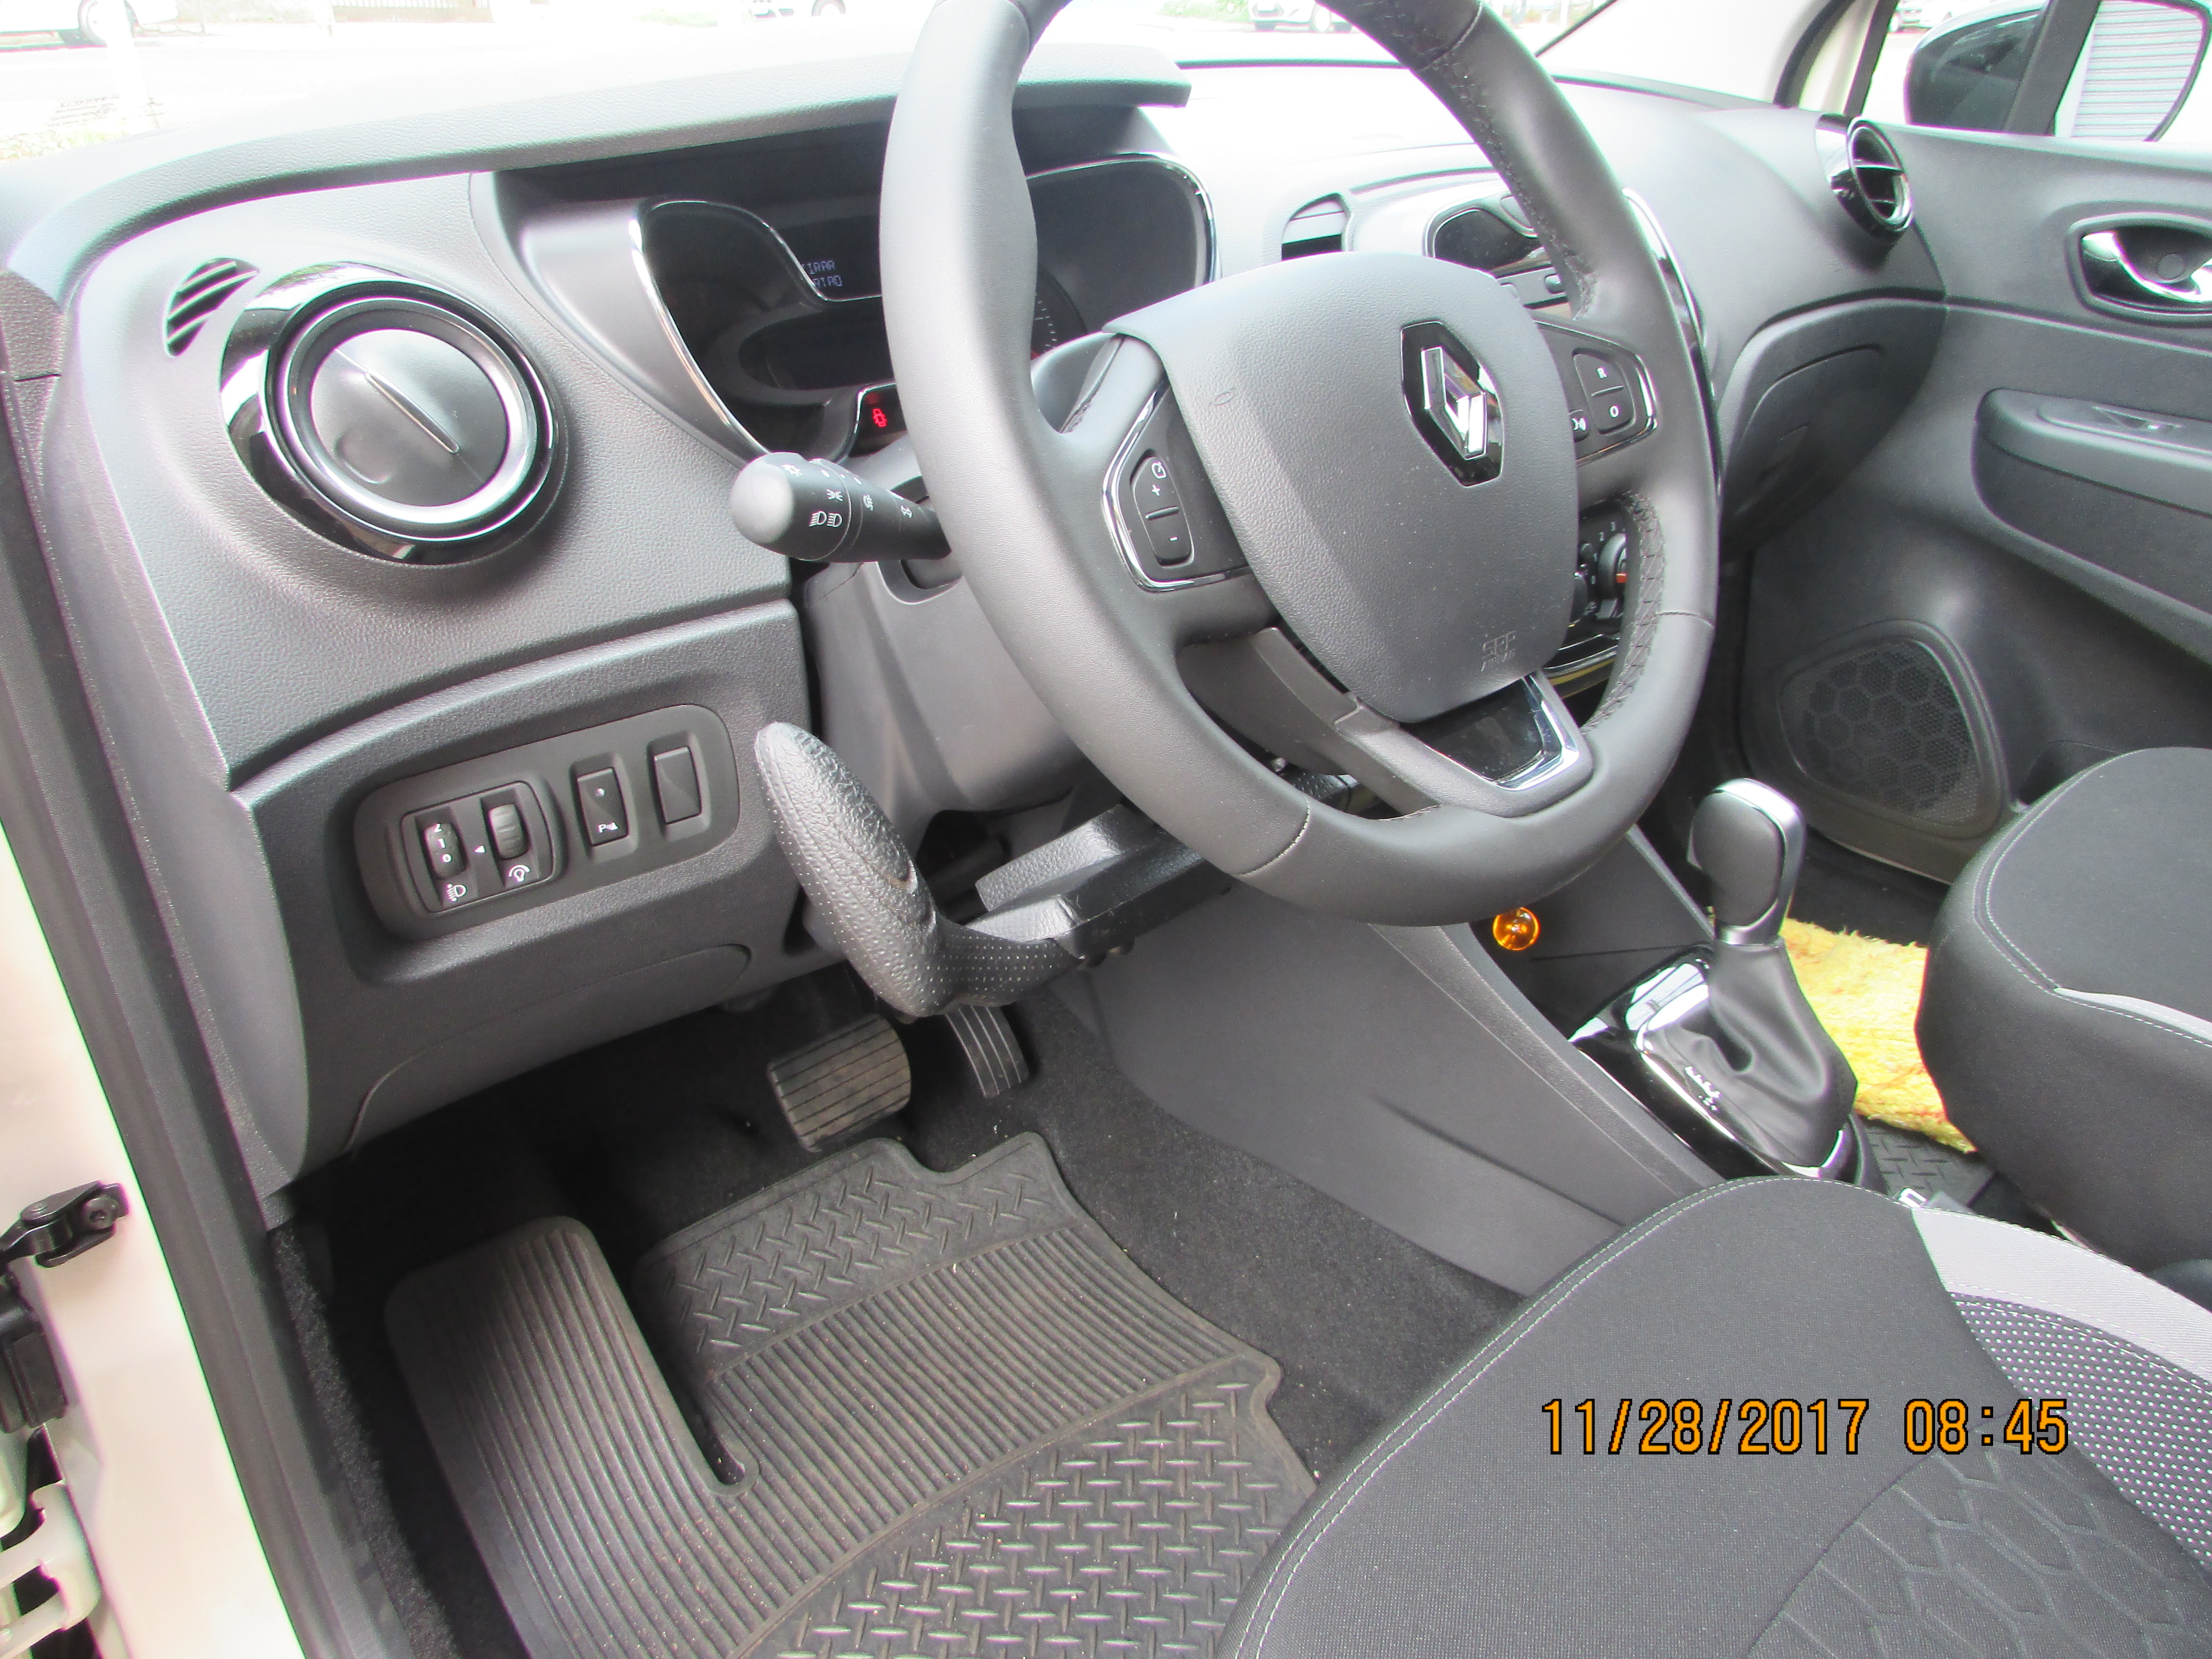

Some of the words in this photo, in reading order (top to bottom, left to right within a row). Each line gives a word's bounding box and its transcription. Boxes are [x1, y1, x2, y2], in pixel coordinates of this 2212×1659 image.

[1596, 367, 1608, 379] R
[433, 823, 442, 832] 2
[437, 838, 445, 848] 1
